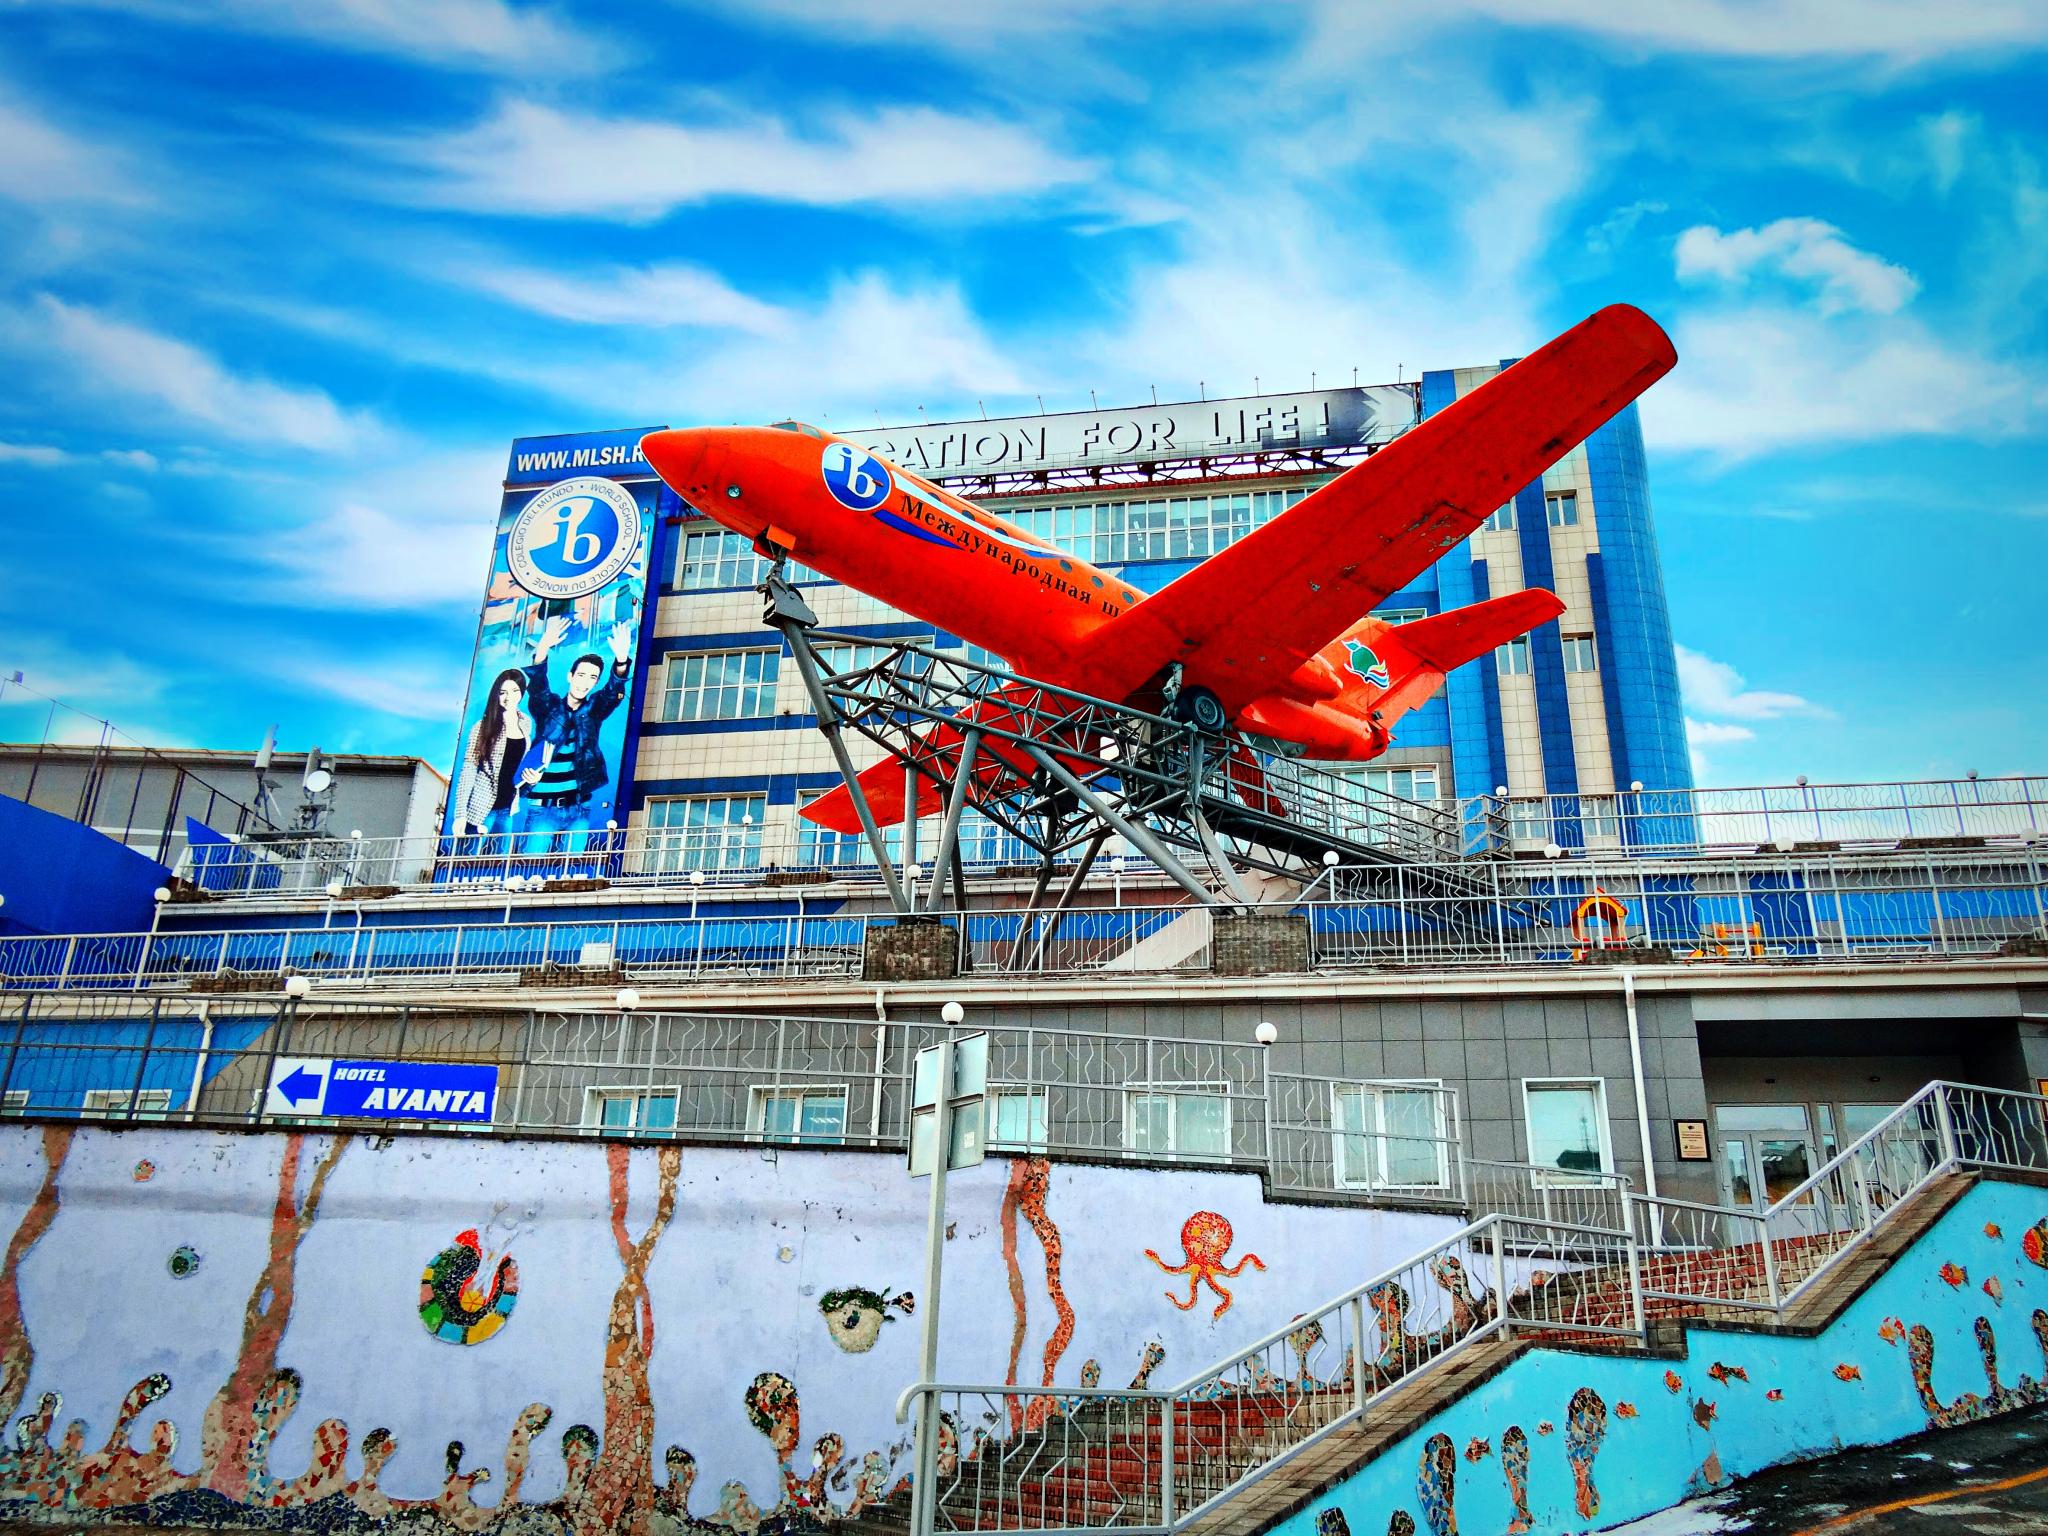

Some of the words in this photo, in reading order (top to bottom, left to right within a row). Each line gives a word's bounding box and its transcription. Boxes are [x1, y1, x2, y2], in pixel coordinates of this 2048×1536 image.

[1077, 416, 1176, 460] FOR
[838, 446, 878, 498] ib
[515, 527, 528, 569] COLEGIO
[524, 508, 537, 526] DEL
[538, 485, 574, 509] MUNDO
[553, 506, 602, 565] ib
[590, 483, 622, 503] WORLD
[618, 501, 633, 540] SCHOOL
[900, 494, 1092, 605] Международная
[1102, 601, 1124, 618] ш
[532, 577, 569, 592] MONDE
[571, 580, 587, 591] DU
[333, 1068, 386, 1082] HOTEL
[361, 1087, 485, 1113] AVANTA
